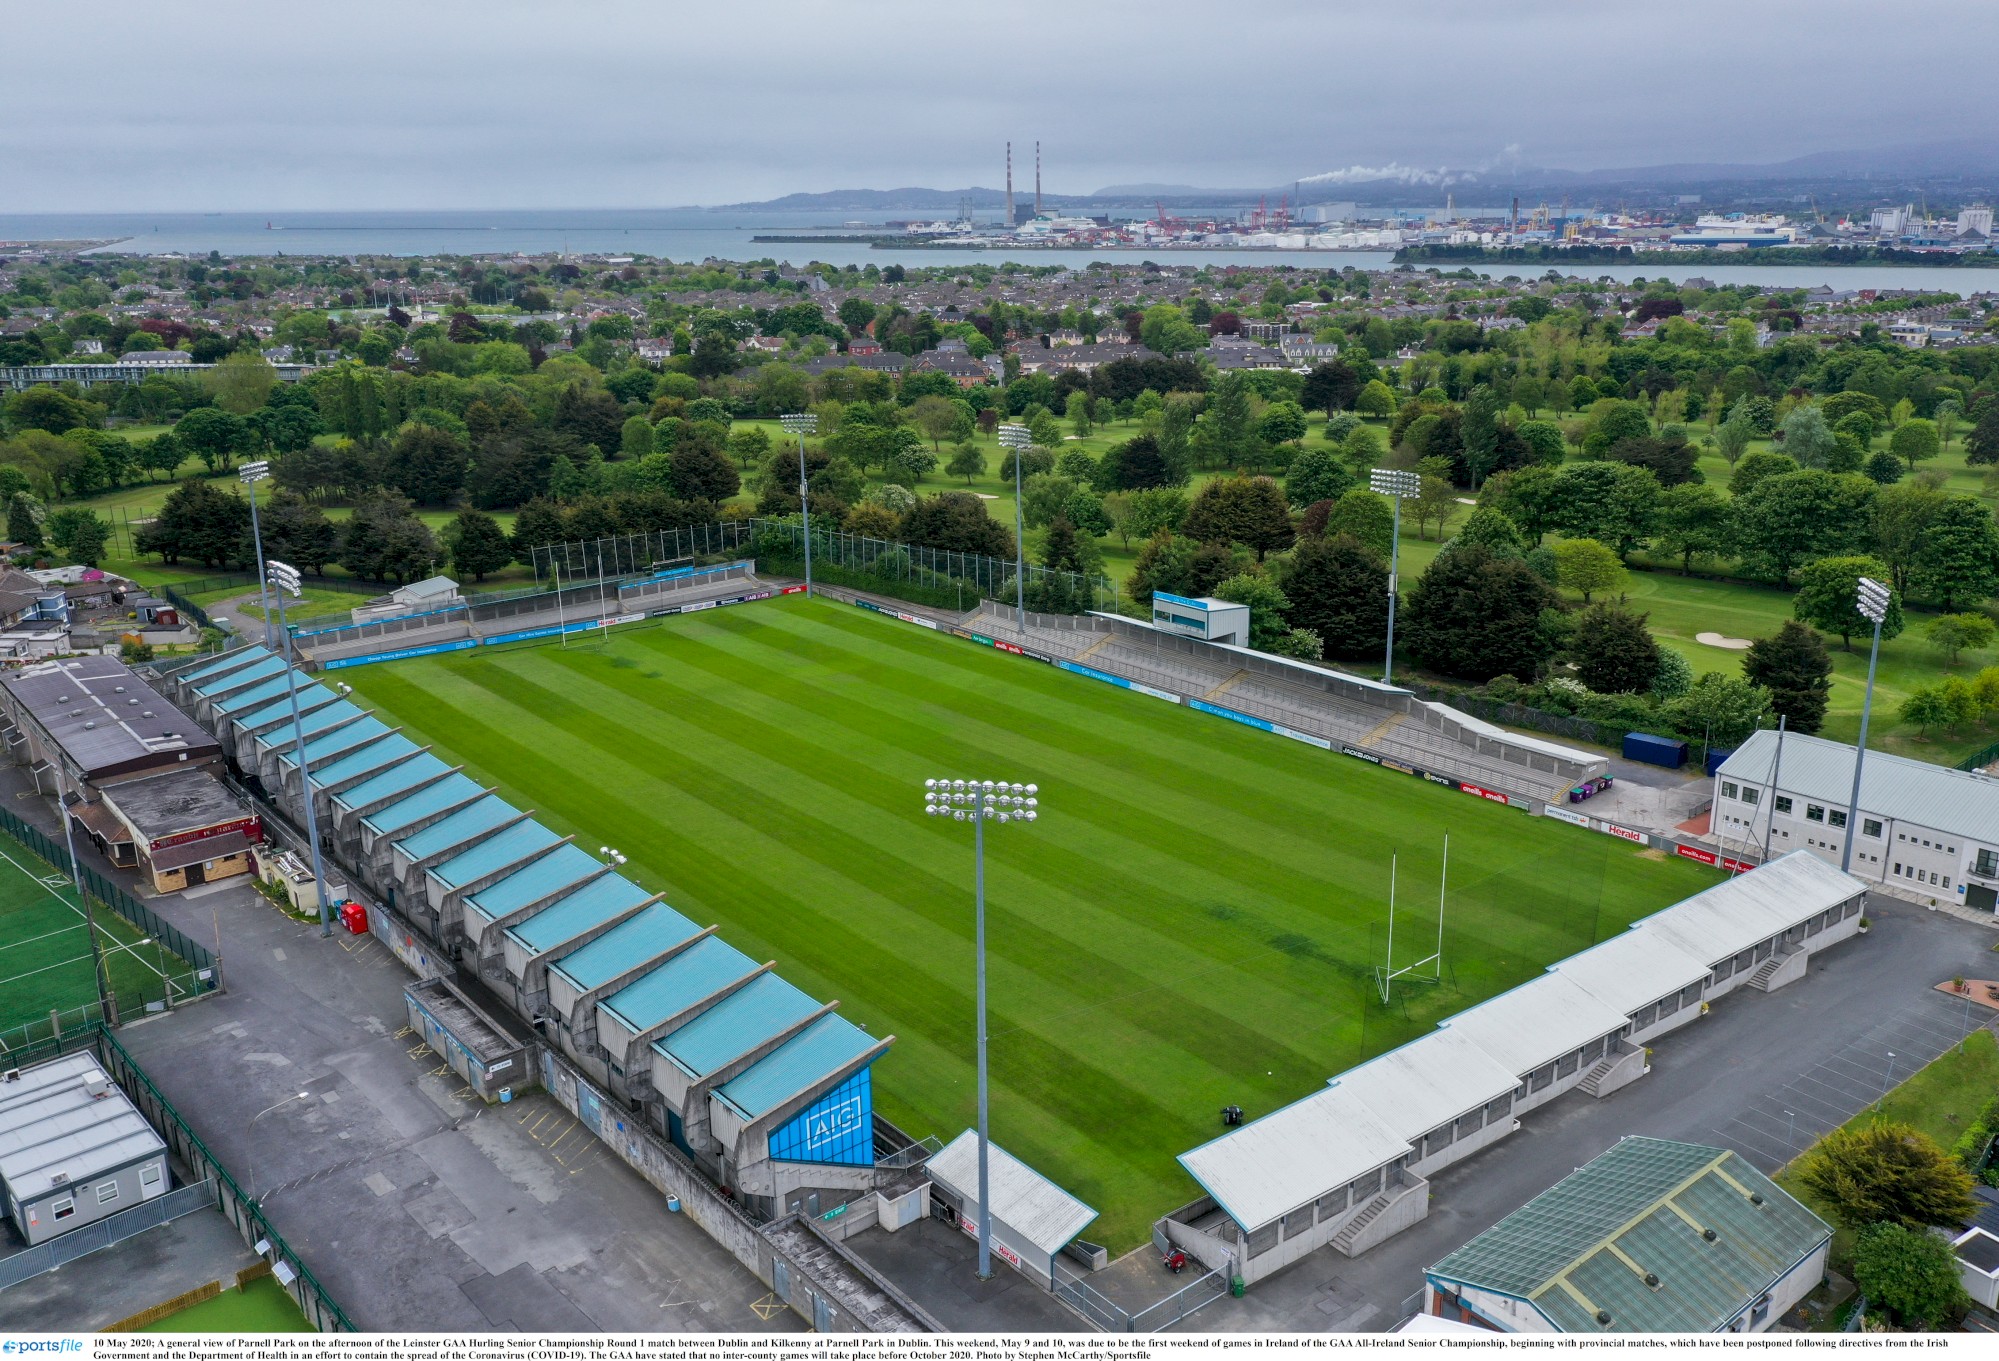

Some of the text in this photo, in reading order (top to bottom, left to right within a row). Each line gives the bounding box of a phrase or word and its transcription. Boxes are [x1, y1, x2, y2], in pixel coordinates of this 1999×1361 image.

[1250, 718, 1261, 727] blue
[1289, 731, 1329, 747] Travel Insurance
[1462, 786, 1483, 796] oneills
[1485, 792, 1506, 804] oneills
[1546, 808, 1579, 822] permanent tsb
[1608, 824, 1641, 842] Herald
[1681, 849, 1711, 862] oneills.com
[813, 1107, 855, 1142] AIG
[999, 1245, 1018, 1265] Herald
